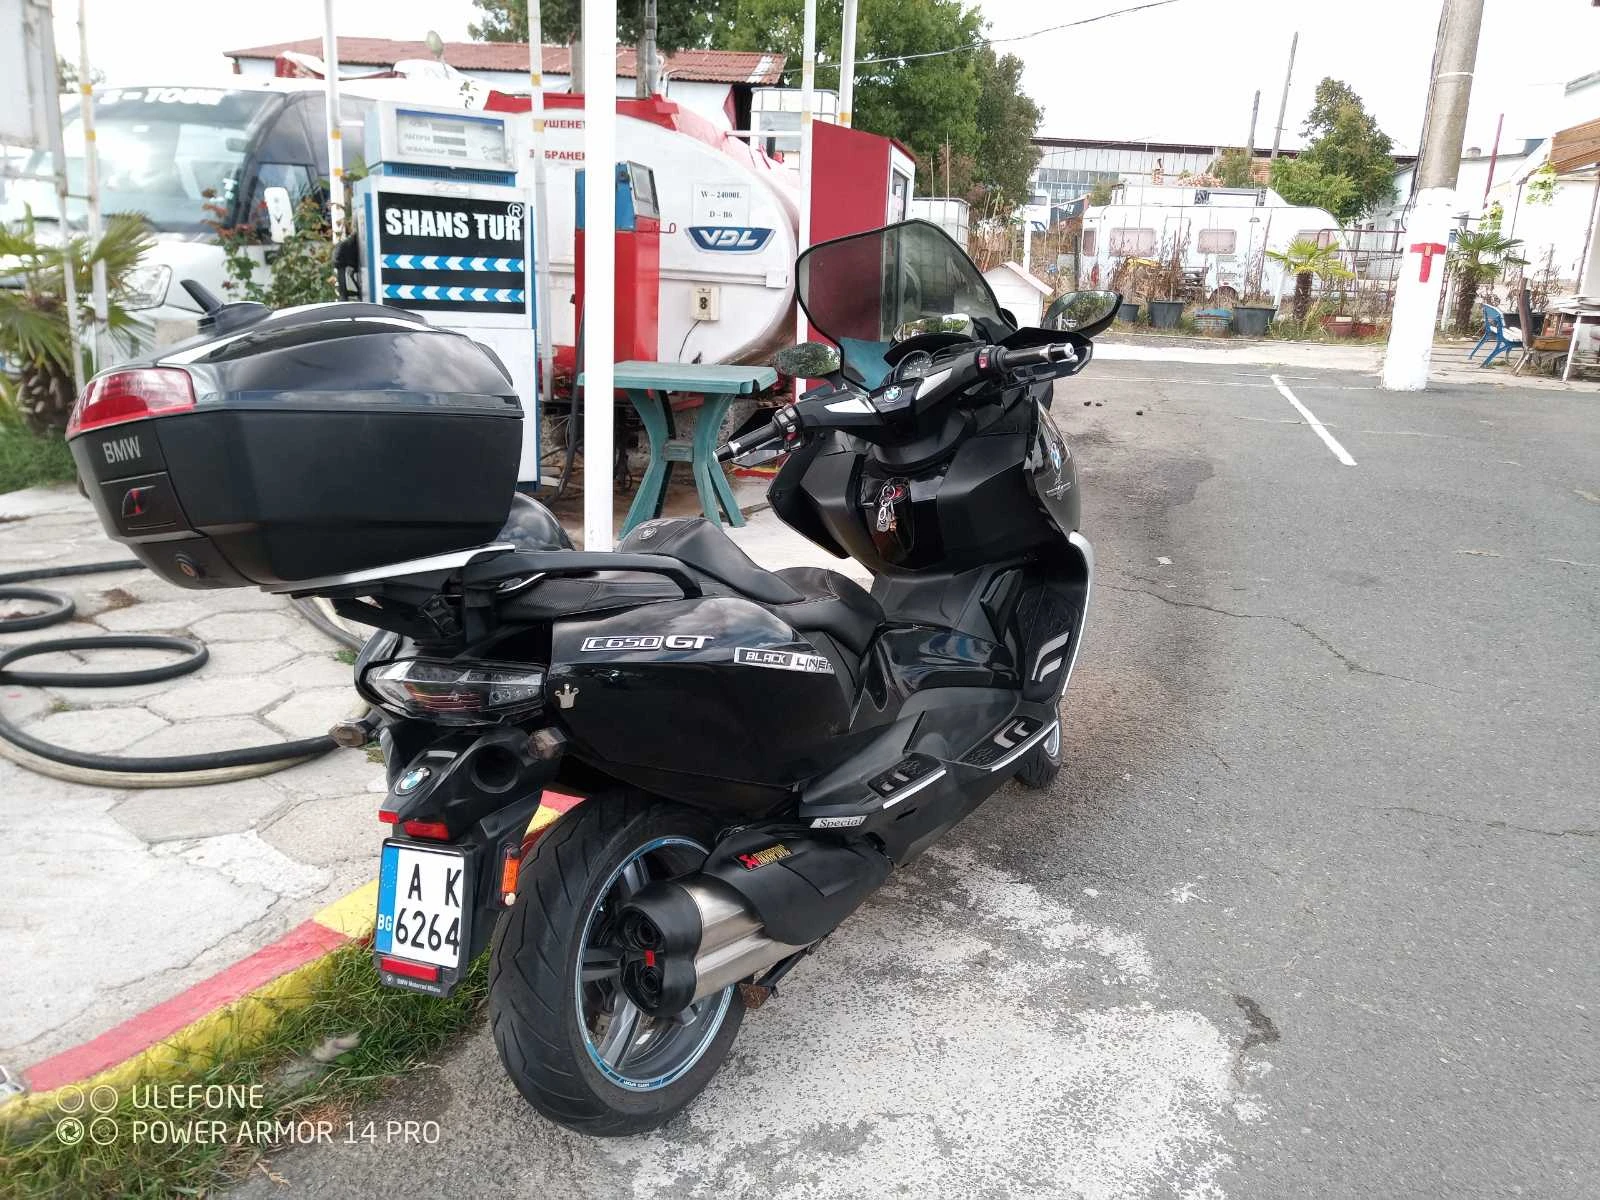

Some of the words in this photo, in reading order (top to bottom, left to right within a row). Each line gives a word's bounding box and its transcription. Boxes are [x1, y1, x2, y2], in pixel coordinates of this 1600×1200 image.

[385, 208, 470, 239] SHANS
[473, 213, 521, 241] TUR
[699, 229, 758, 247] VDL
[102, 435, 142, 464] BMW
[589, 637, 660, 649] C650
[665, 635, 714, 649] GT
[745, 651, 786, 665] BLACK
[820, 818, 862, 828] Special
[408, 863, 422, 901] A
[445, 867, 462, 908] K
[377, 913, 393, 932] BG
[395, 907, 460, 956] 6264
